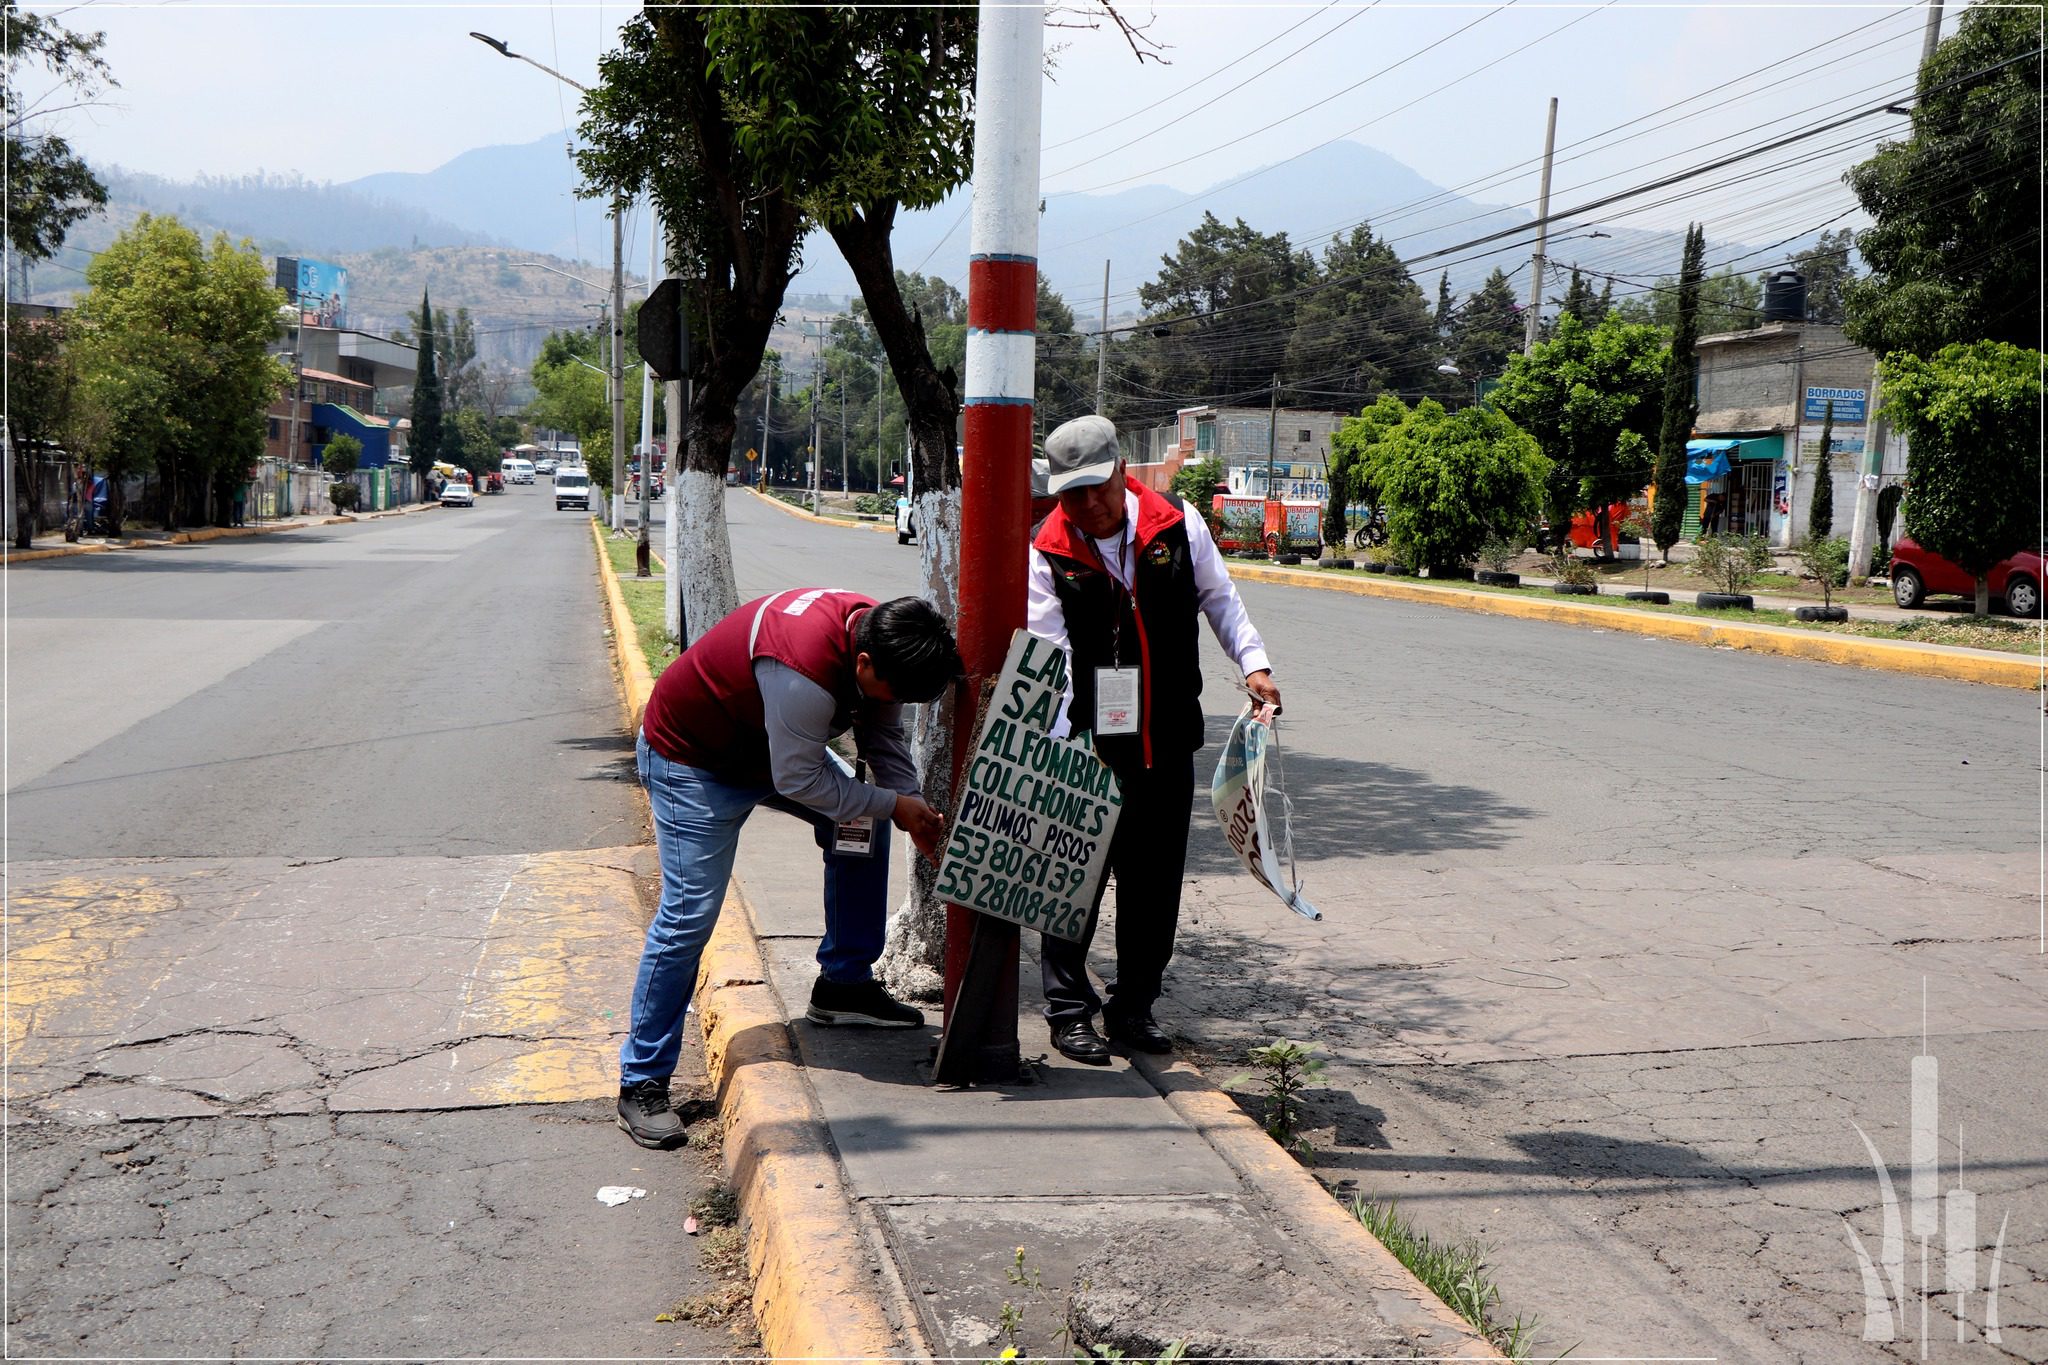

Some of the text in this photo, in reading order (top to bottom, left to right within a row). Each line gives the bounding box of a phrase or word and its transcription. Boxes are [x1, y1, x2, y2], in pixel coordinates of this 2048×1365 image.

[1808, 387, 1865, 400] BORDADOS
[960, 790, 1097, 867] PULIMOS PISOS
[969, 755, 1109, 837] COLCHONES
